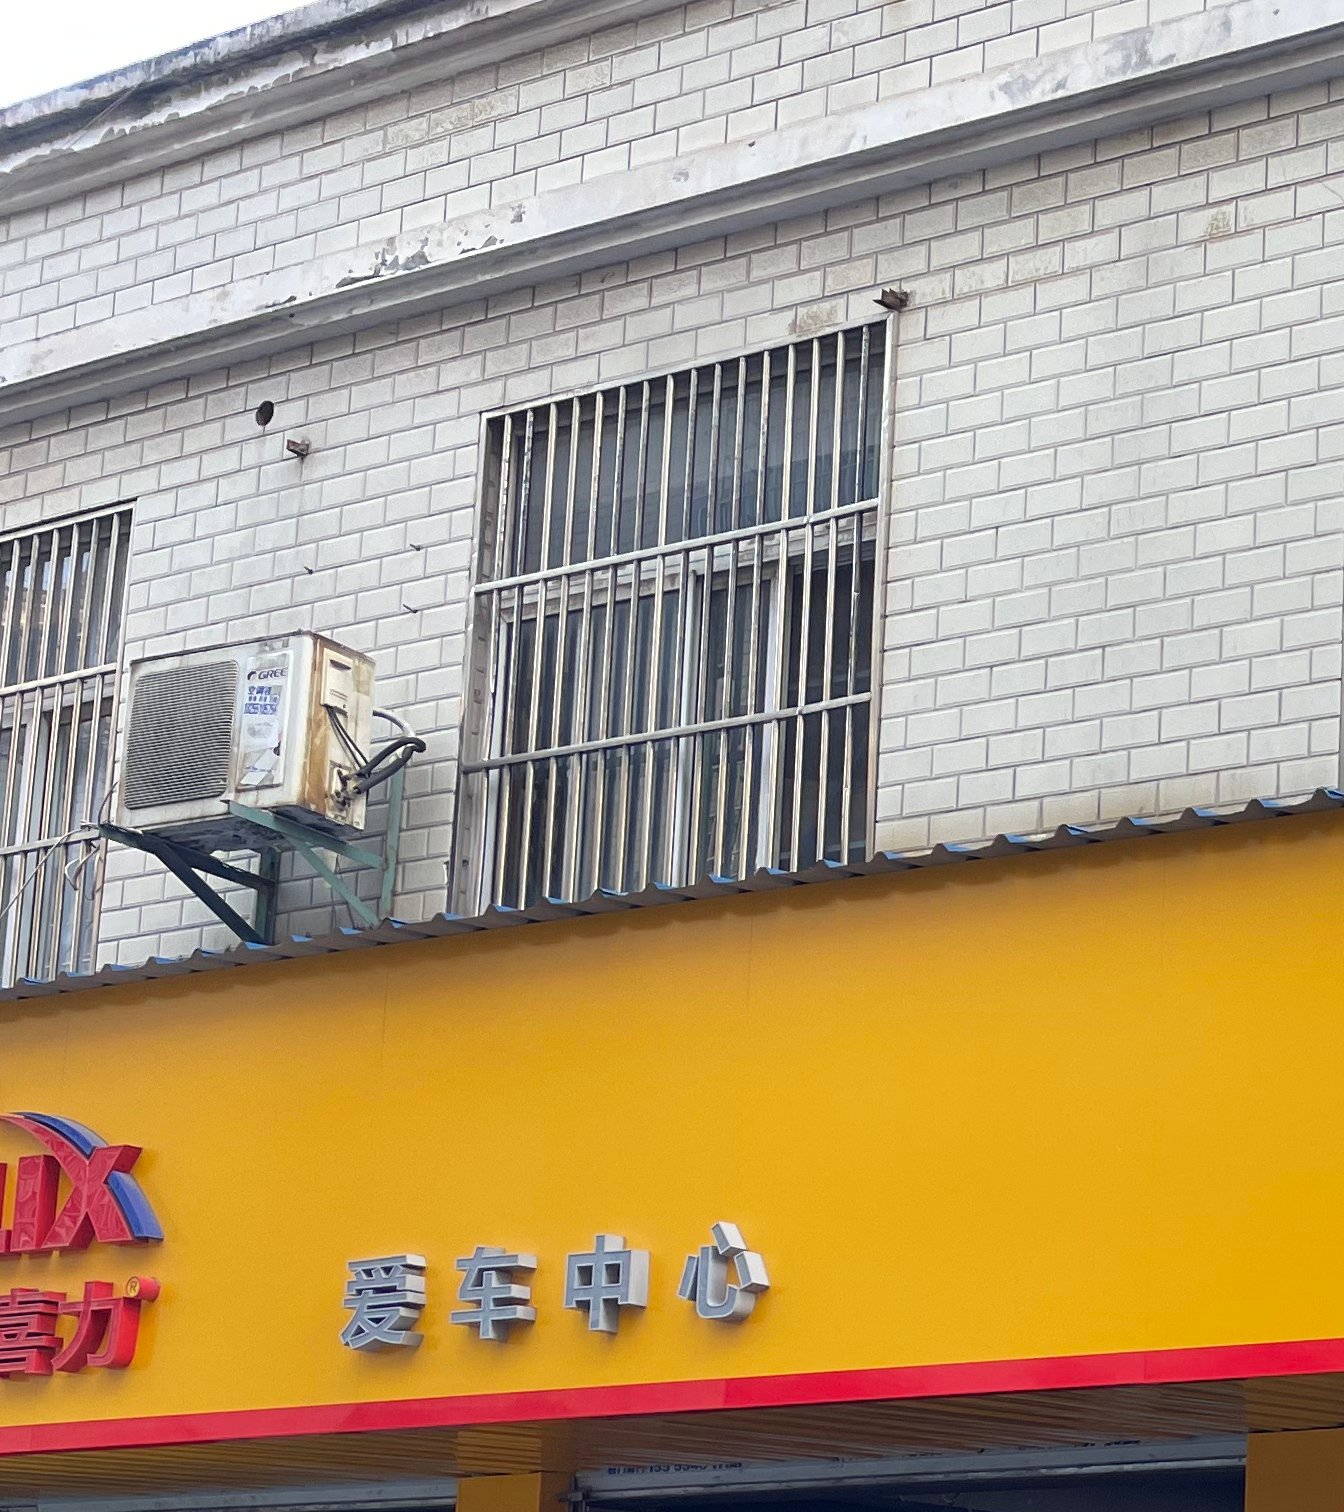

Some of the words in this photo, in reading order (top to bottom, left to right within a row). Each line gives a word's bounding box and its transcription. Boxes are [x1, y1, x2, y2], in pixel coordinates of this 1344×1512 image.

[258, 667, 288, 680] GREE
[339, 1220, 770, 1351] 爱车中心
